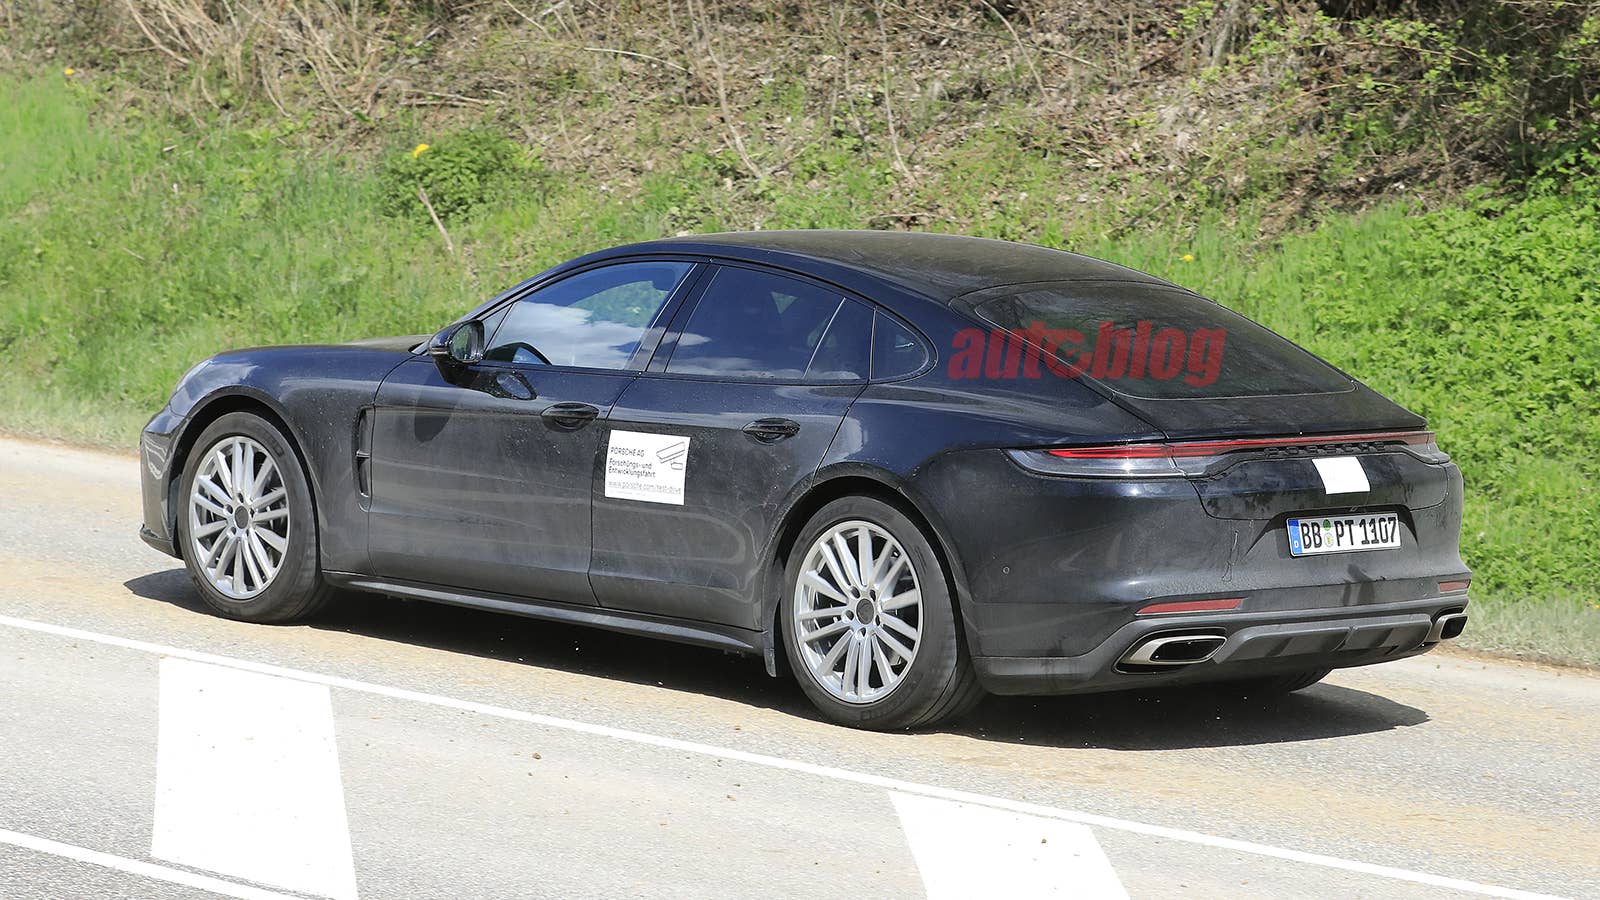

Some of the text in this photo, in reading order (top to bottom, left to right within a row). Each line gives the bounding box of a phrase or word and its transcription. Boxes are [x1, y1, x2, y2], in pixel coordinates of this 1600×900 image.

[610, 446, 645, 458] PORSCHE AG
[1264, 441, 1386, 458] PORSCHE
[641, 462, 652, 470] und
[1300, 522, 1322, 549] BB
[1334, 519, 1354, 547] PT
[1359, 517, 1397, 545] 1107
